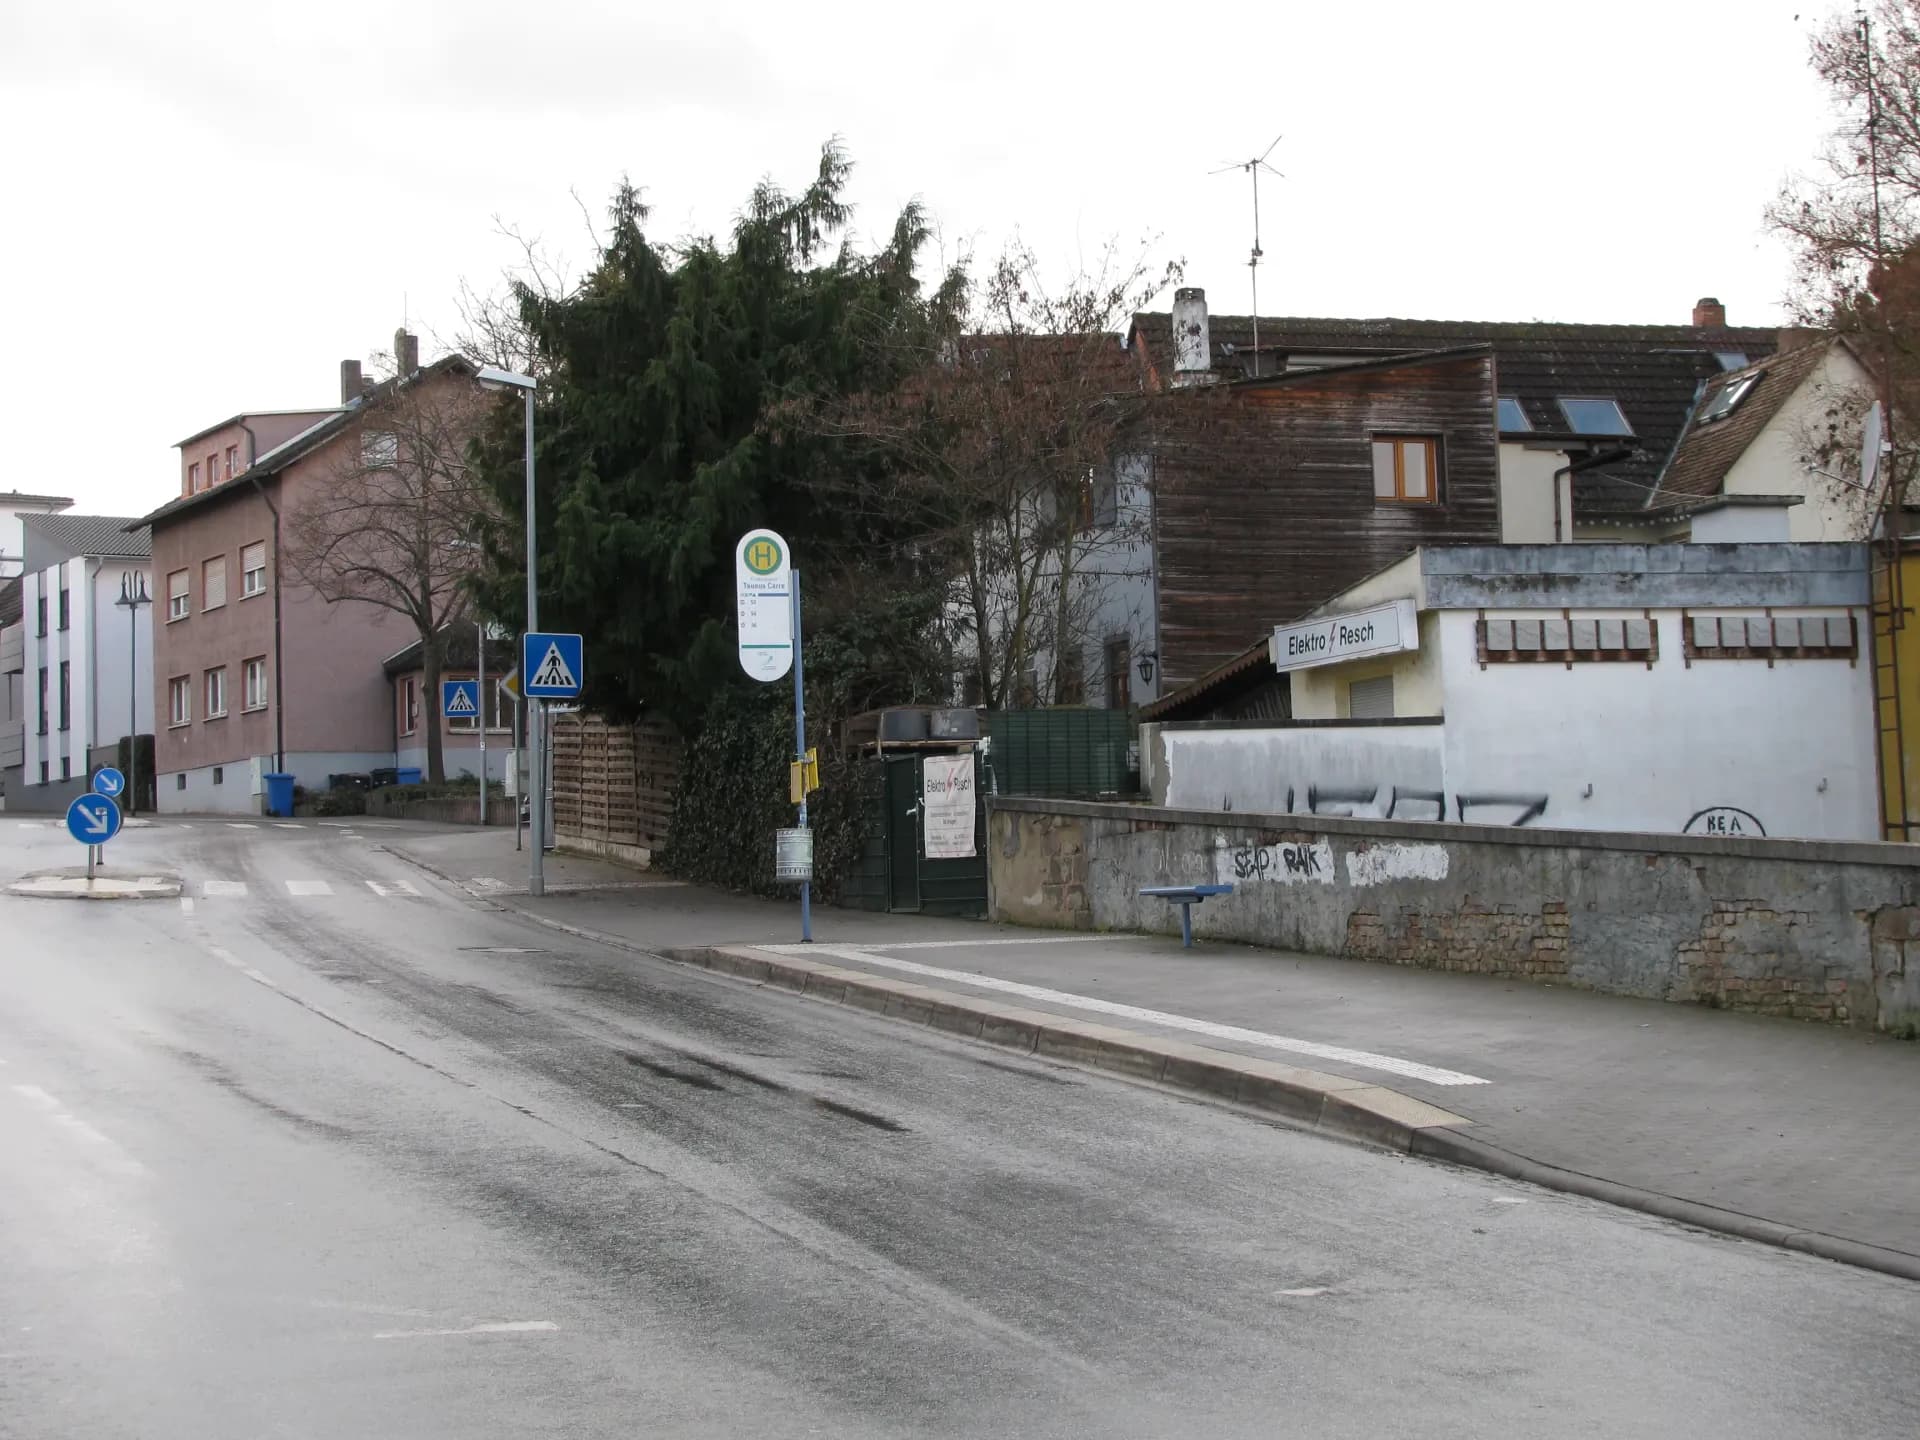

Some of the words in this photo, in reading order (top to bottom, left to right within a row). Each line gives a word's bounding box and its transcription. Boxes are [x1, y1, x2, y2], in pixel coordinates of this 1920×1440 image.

[755, 545, 771, 567] H
[1288, 634, 1326, 656] Elektro
[1339, 620, 1374, 646] Resch
[926, 779, 946, 793] Elektro
